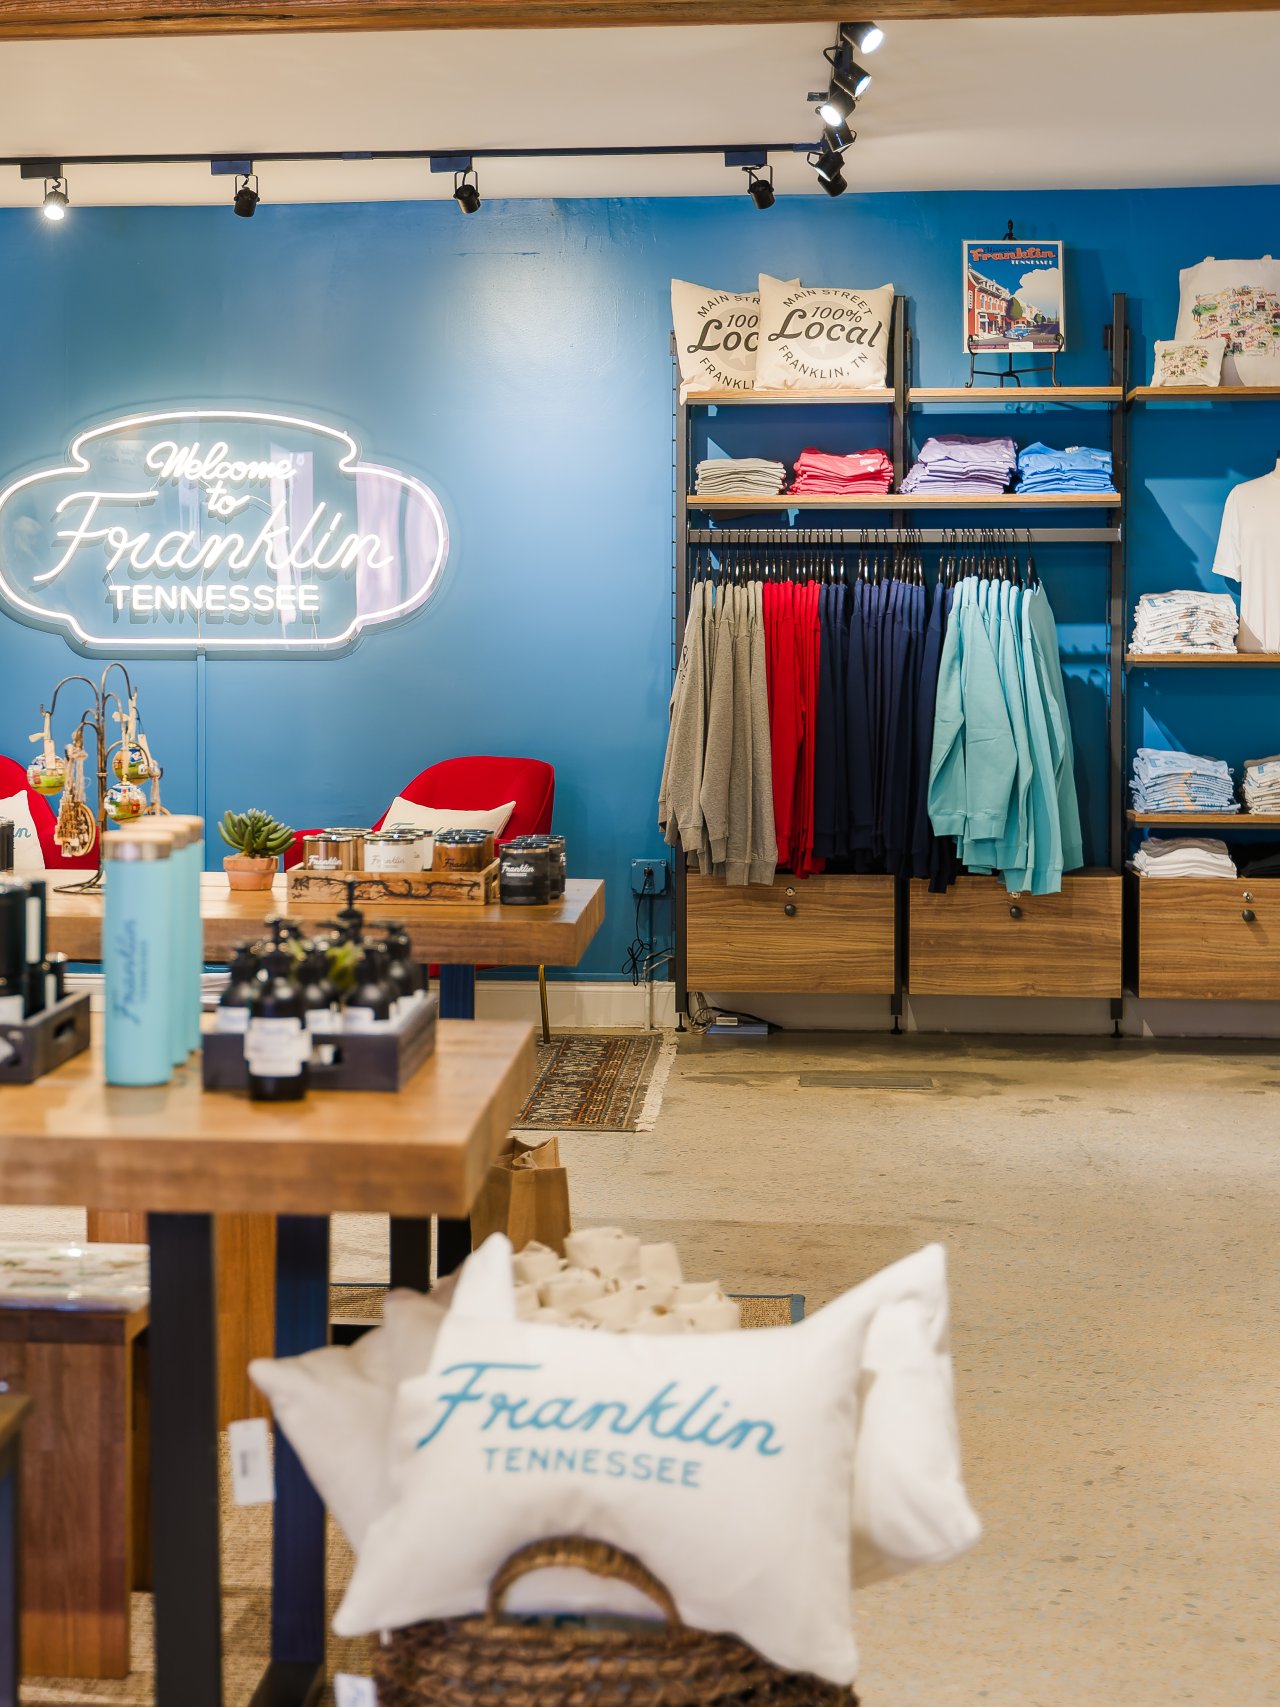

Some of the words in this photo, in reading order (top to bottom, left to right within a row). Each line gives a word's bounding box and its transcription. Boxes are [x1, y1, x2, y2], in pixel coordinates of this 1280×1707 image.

[970, 247, 1056, 262] Franklin
[697, 294, 730, 317] MAIN
[783, 289, 817, 307] MAIN
[822, 289, 873, 316] STREET
[811, 306, 862, 323] 100%
[767, 308, 883, 348] Local
[851, 352, 869, 369] TN
[146, 441, 299, 481] Welcome
[205, 480, 250, 516] to
[32, 490, 395, 583] Franklin
[108, 584, 321, 612] TENNESSEE
[308, 855, 341, 866] Franklin
[370, 855, 406, 867] Frnklin
[501, 862, 535, 874] Franklin
[418, 1361, 784, 1457] Franklin
[483, 1446, 703, 1489] TENNESSEE
